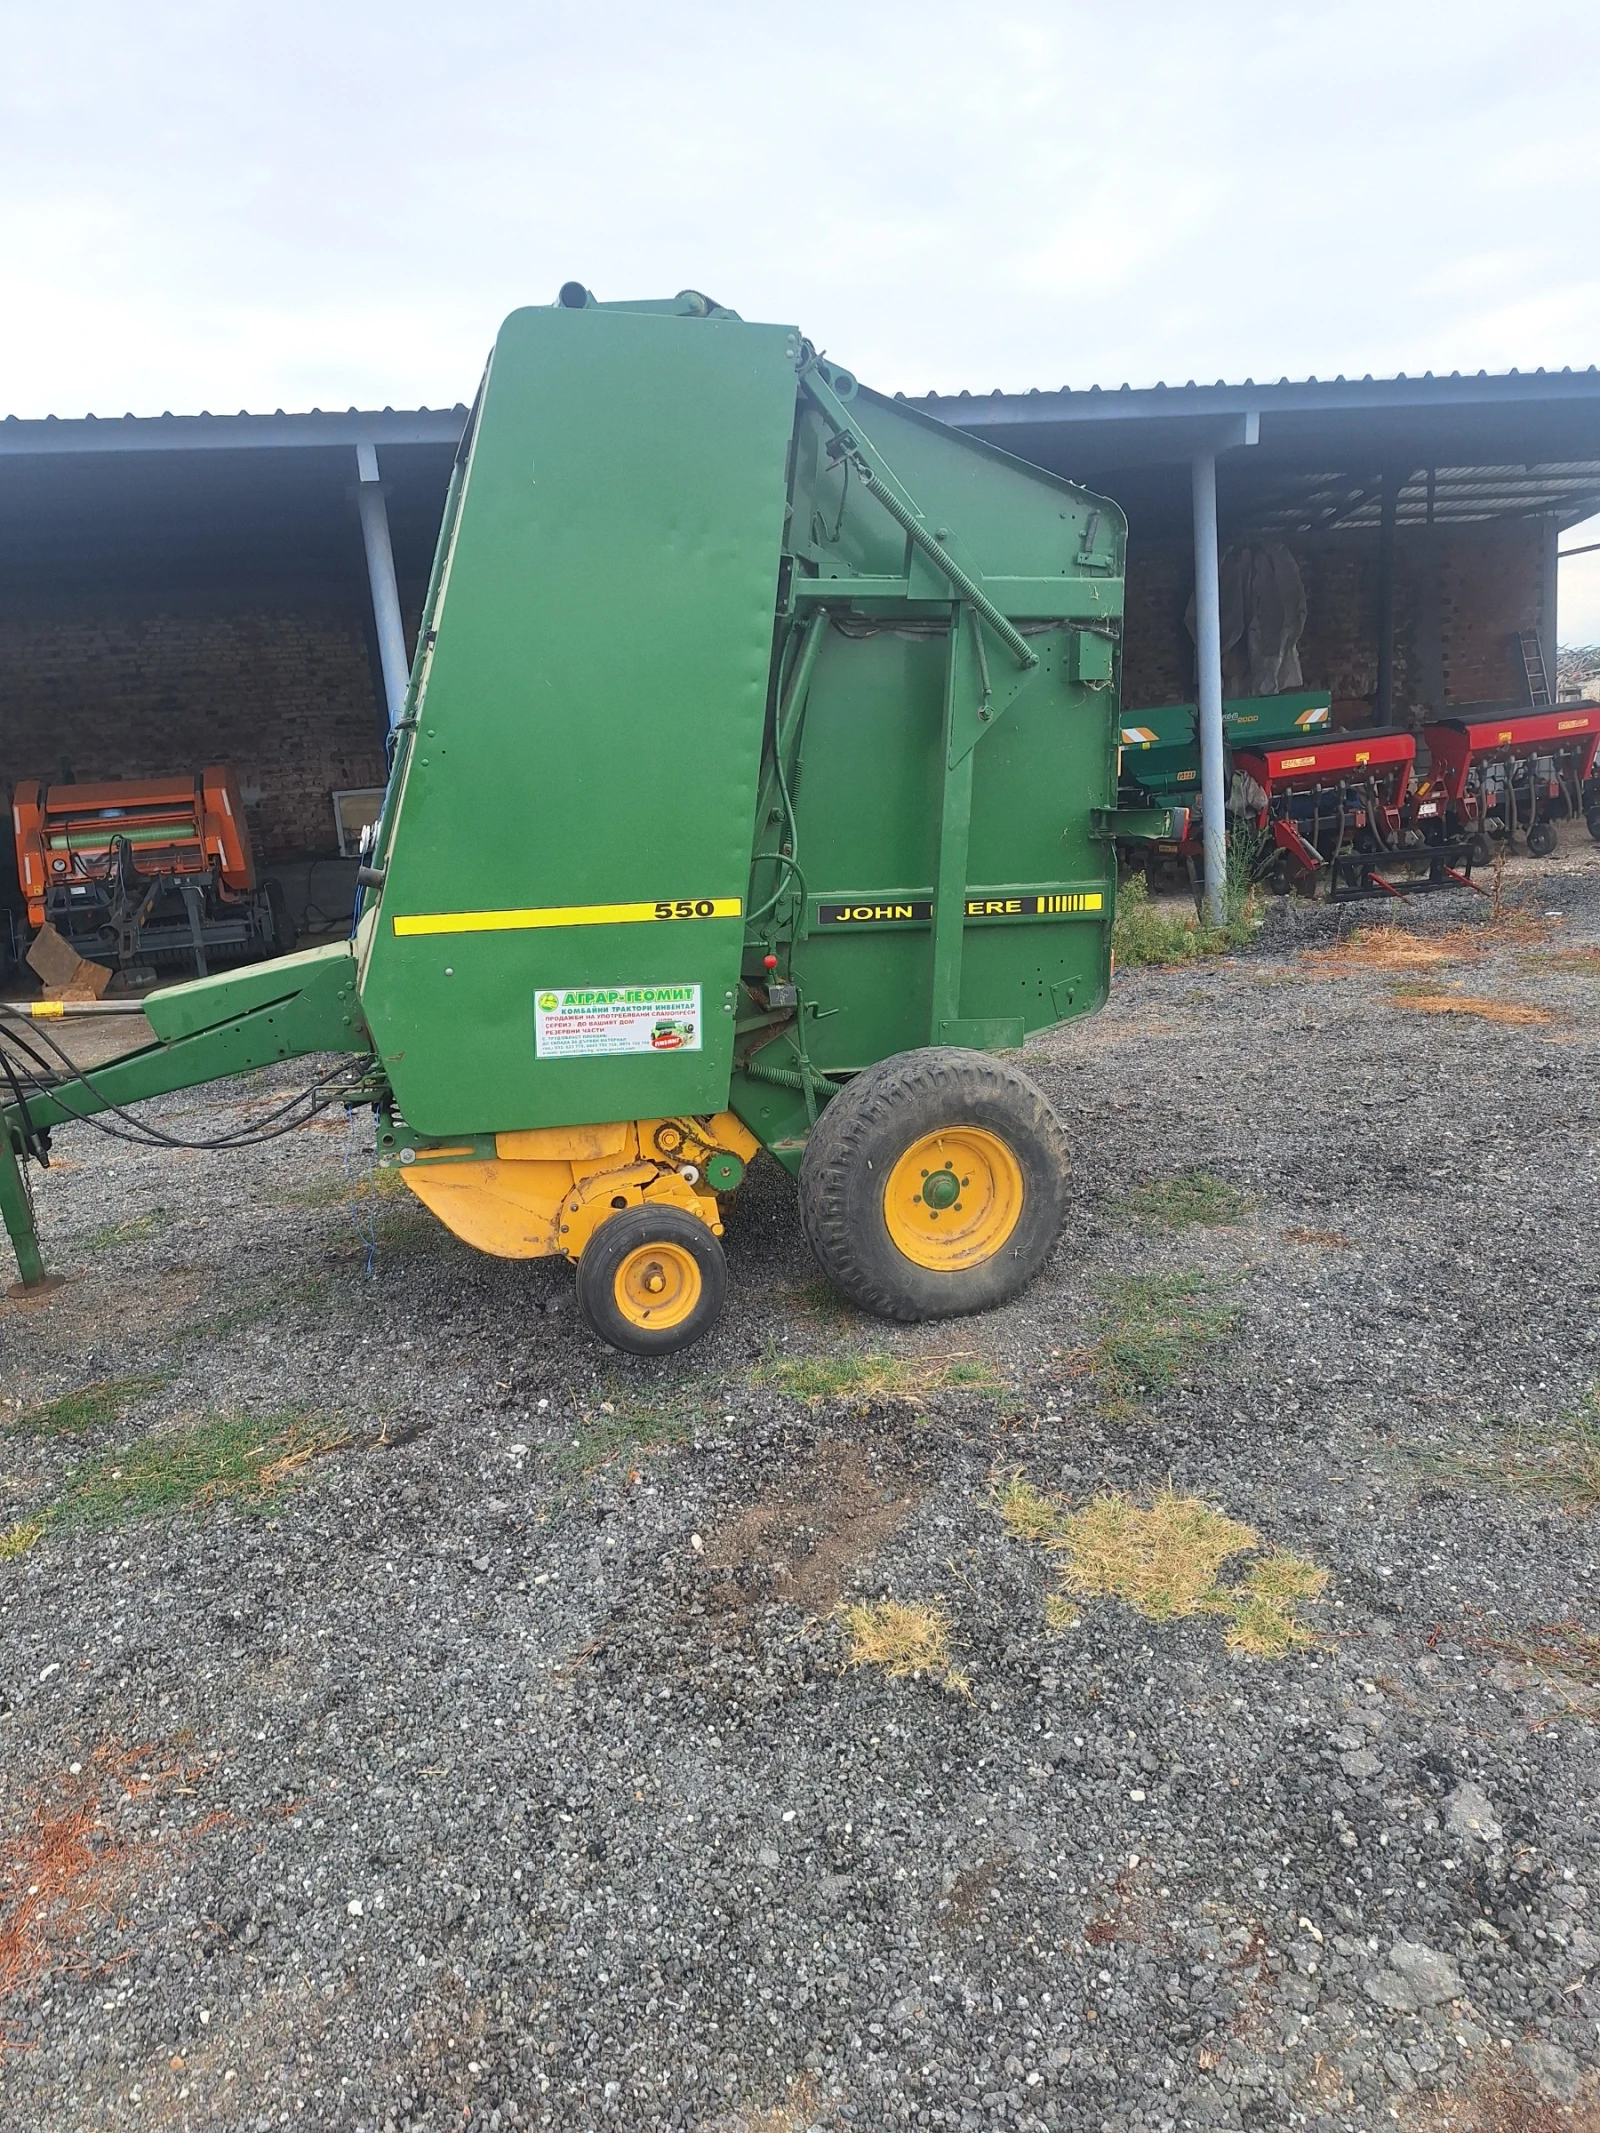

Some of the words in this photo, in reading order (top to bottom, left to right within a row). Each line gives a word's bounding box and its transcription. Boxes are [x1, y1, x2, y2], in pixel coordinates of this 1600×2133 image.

[654, 901, 714, 919] 550
[836, 905, 912, 921] JOHN
[930, 900, 1021, 916] ERE
[563, 988, 694, 1006] АГРАР-ГЕОМИТ
[545, 1014, 584, 1022] ПРОДАЖБИ
[597, 1011, 650, 1019] УПОТРЕБЯВАНИ
[561, 1006, 609, 1015] КОМБАЙНИ
[612, 1005, 652, 1013] ТРАКТОРИ
[655, 1003, 695, 1011] ИНВЕНТАР
